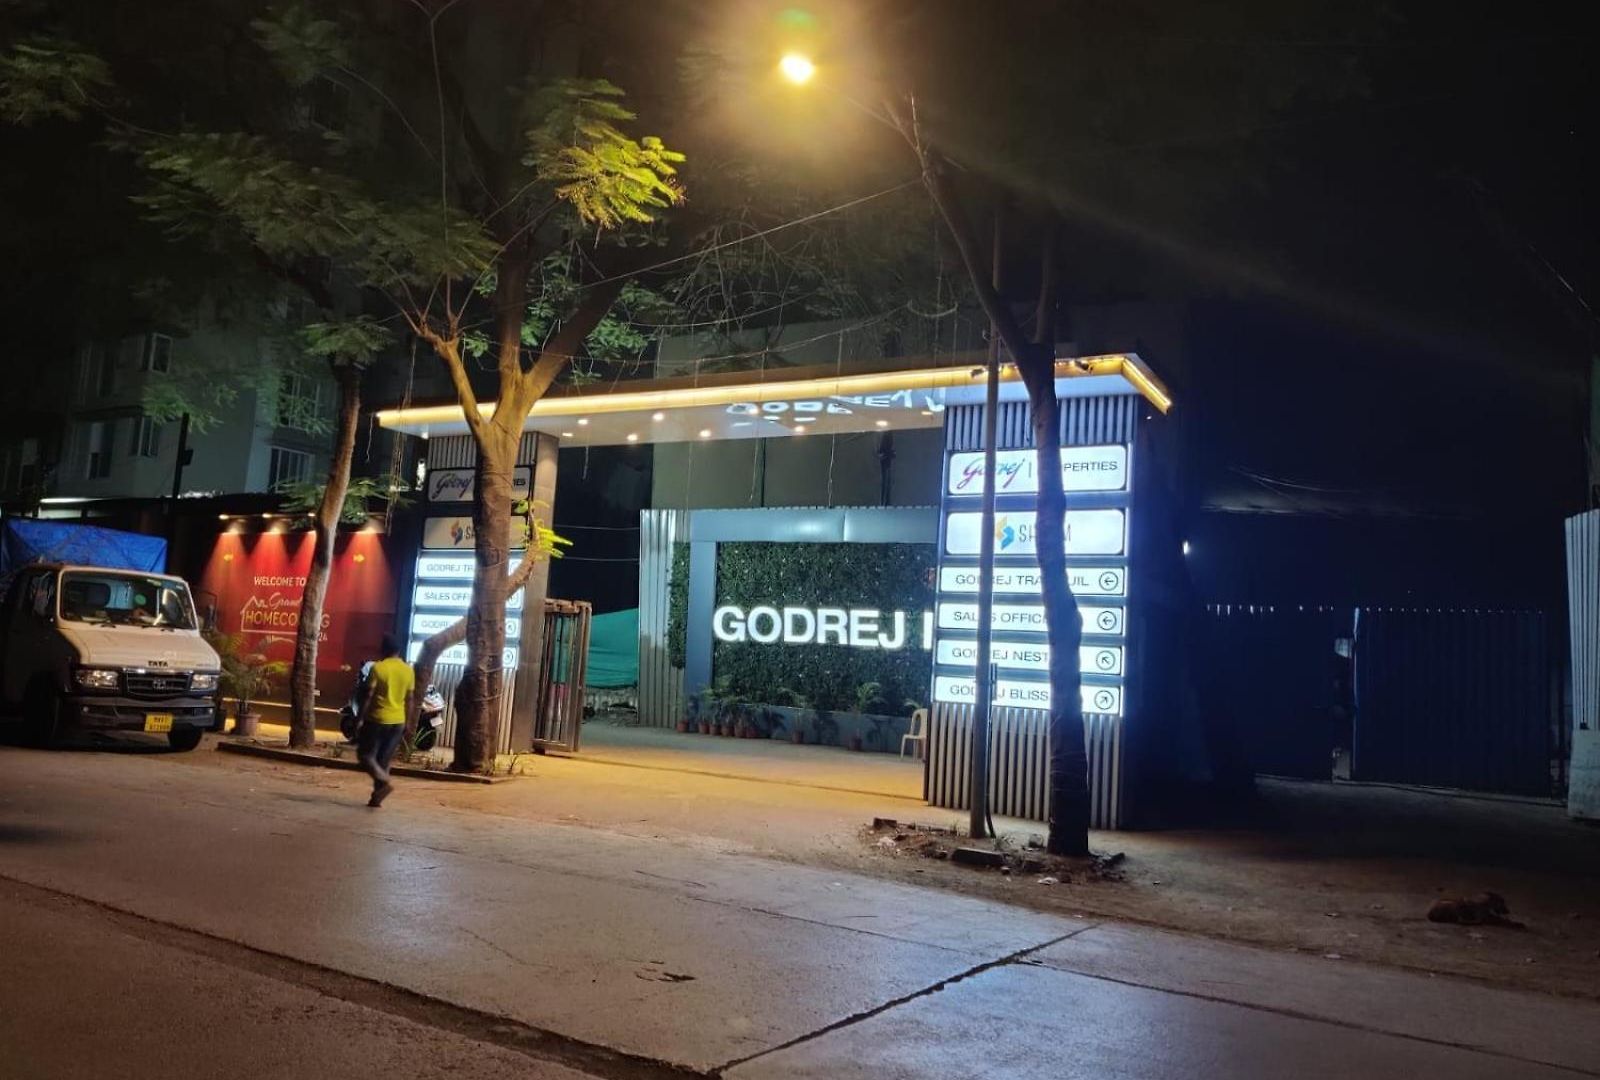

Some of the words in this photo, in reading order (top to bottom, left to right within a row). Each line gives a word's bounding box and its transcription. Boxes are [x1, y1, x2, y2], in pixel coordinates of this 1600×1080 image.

[1063, 460, 1118, 472] PERTIES
[254, 575, 295, 587] WELCOME
[295, 576, 307, 587] TO
[955, 574, 1012, 586] GOEJ
[1015, 575, 1090, 587] TRAUIL
[245, 610, 331, 629] HOMECOG
[953, 611, 997, 623] SALS
[1000, 612, 1046, 624] OFFIC
[712, 605, 906, 649] GODREJ
[952, 647, 1008, 660] GOEJ
[1010, 688, 1049, 701] BLISS
